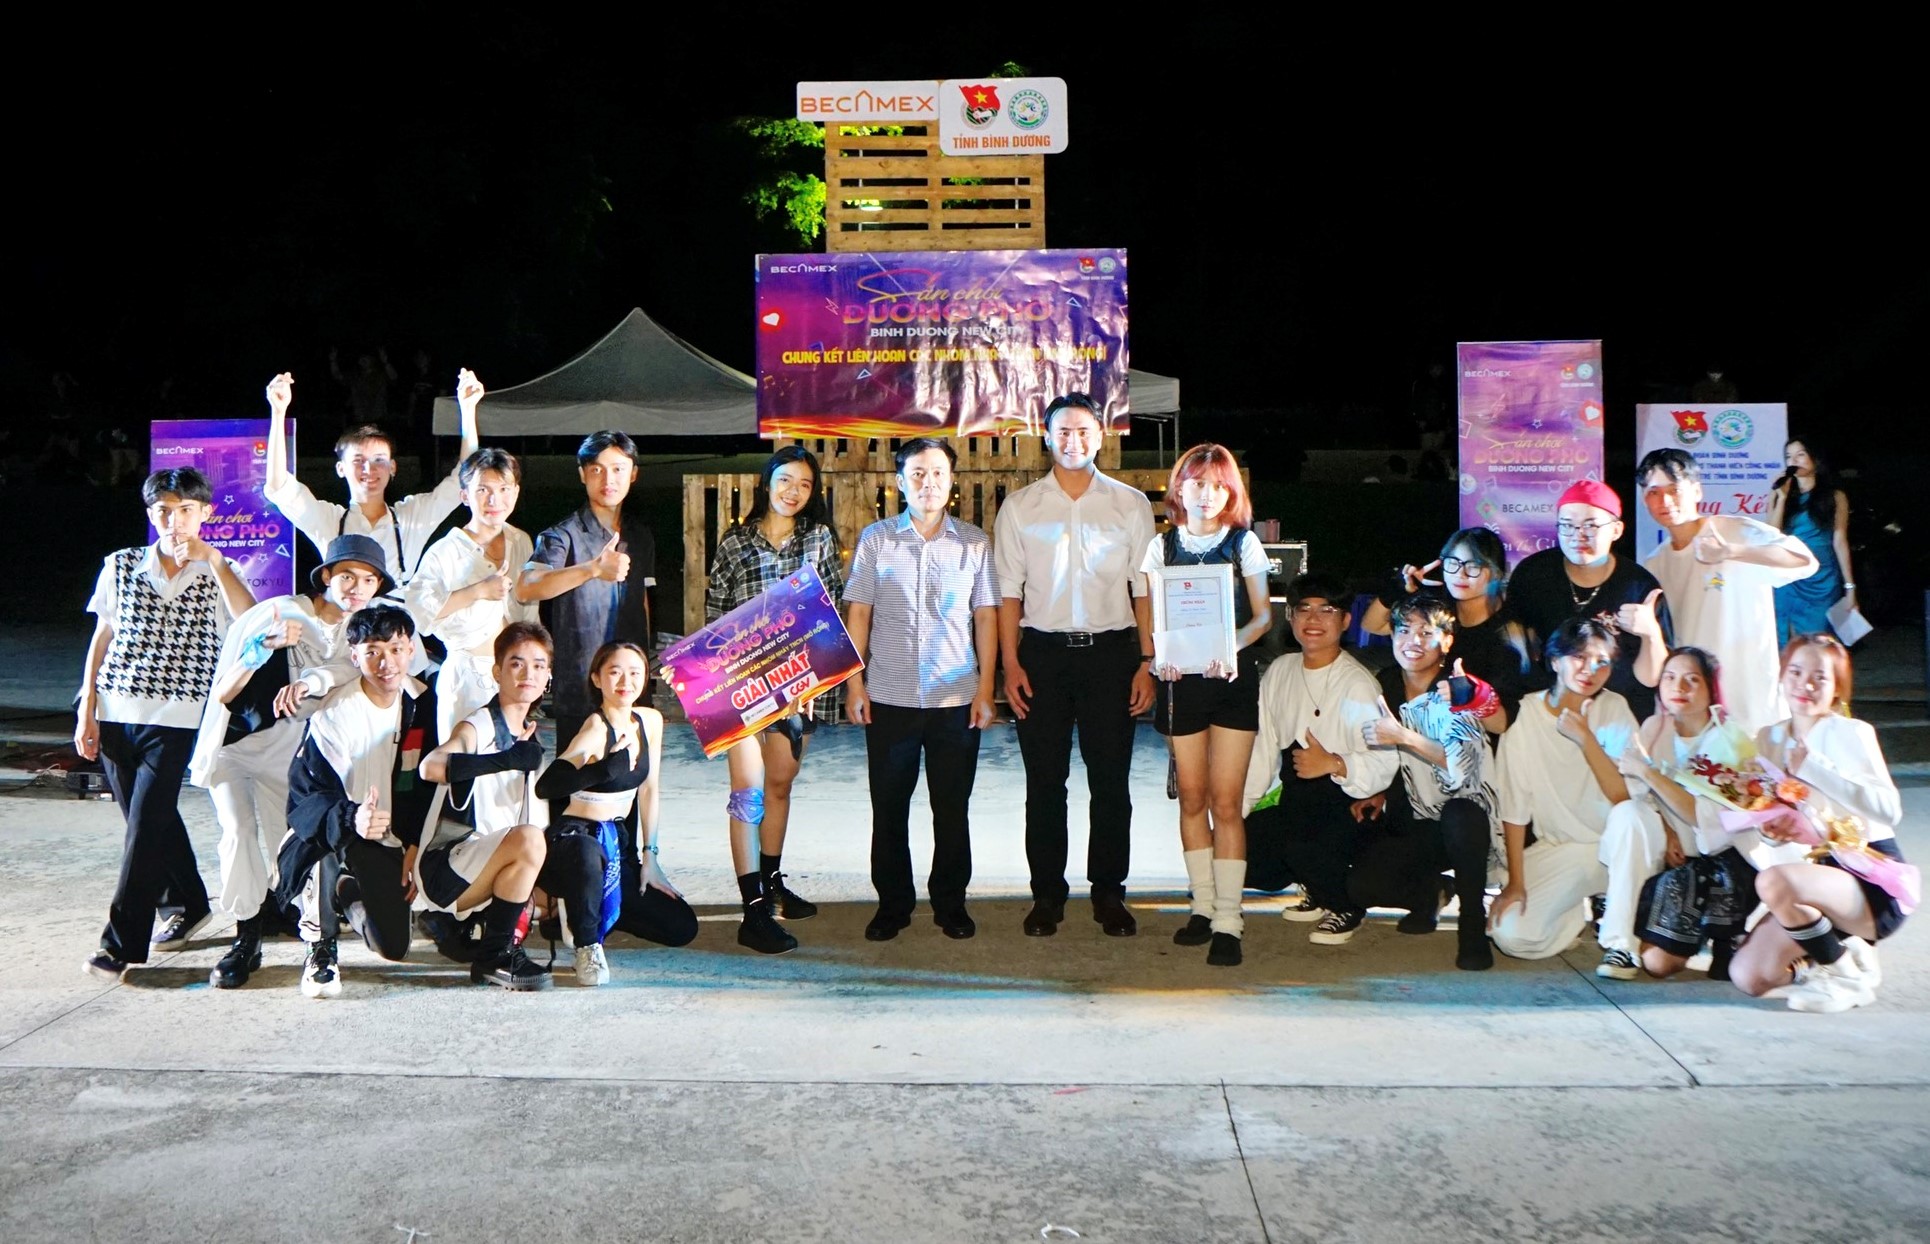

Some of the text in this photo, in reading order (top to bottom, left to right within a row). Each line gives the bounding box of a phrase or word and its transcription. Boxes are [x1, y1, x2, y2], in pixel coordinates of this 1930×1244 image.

[800, 89, 934, 113] BECAMEX
[953, 133, 978, 149] TỈNH
[982, 132, 1009, 148] BÌNH
[770, 263, 837, 273] BECAMEX
[870, 325, 1026, 337] BINH DUONG NEW CITY
[782, 350, 821, 364] CHUNG
[873, 349, 906, 362] HOAN
[156, 446, 204, 455] BECAMEX
[1488, 465, 1506, 473] BINH
[1557, 464, 1574, 472] CITY
[1502, 503, 1553, 513] BECAMEX
[1696, 493, 1767, 515] ng Kế
[229, 540, 247, 548] NEW
[247, 539, 265, 547] CITY
[740, 649, 763, 665] DUONG
[762, 640, 777, 652] NEW
[776, 631, 790, 643] CITY
[732, 678, 769, 709] GIẢI
[765, 651, 811, 690] NHẤT
[790, 677, 810, 695] CGV
